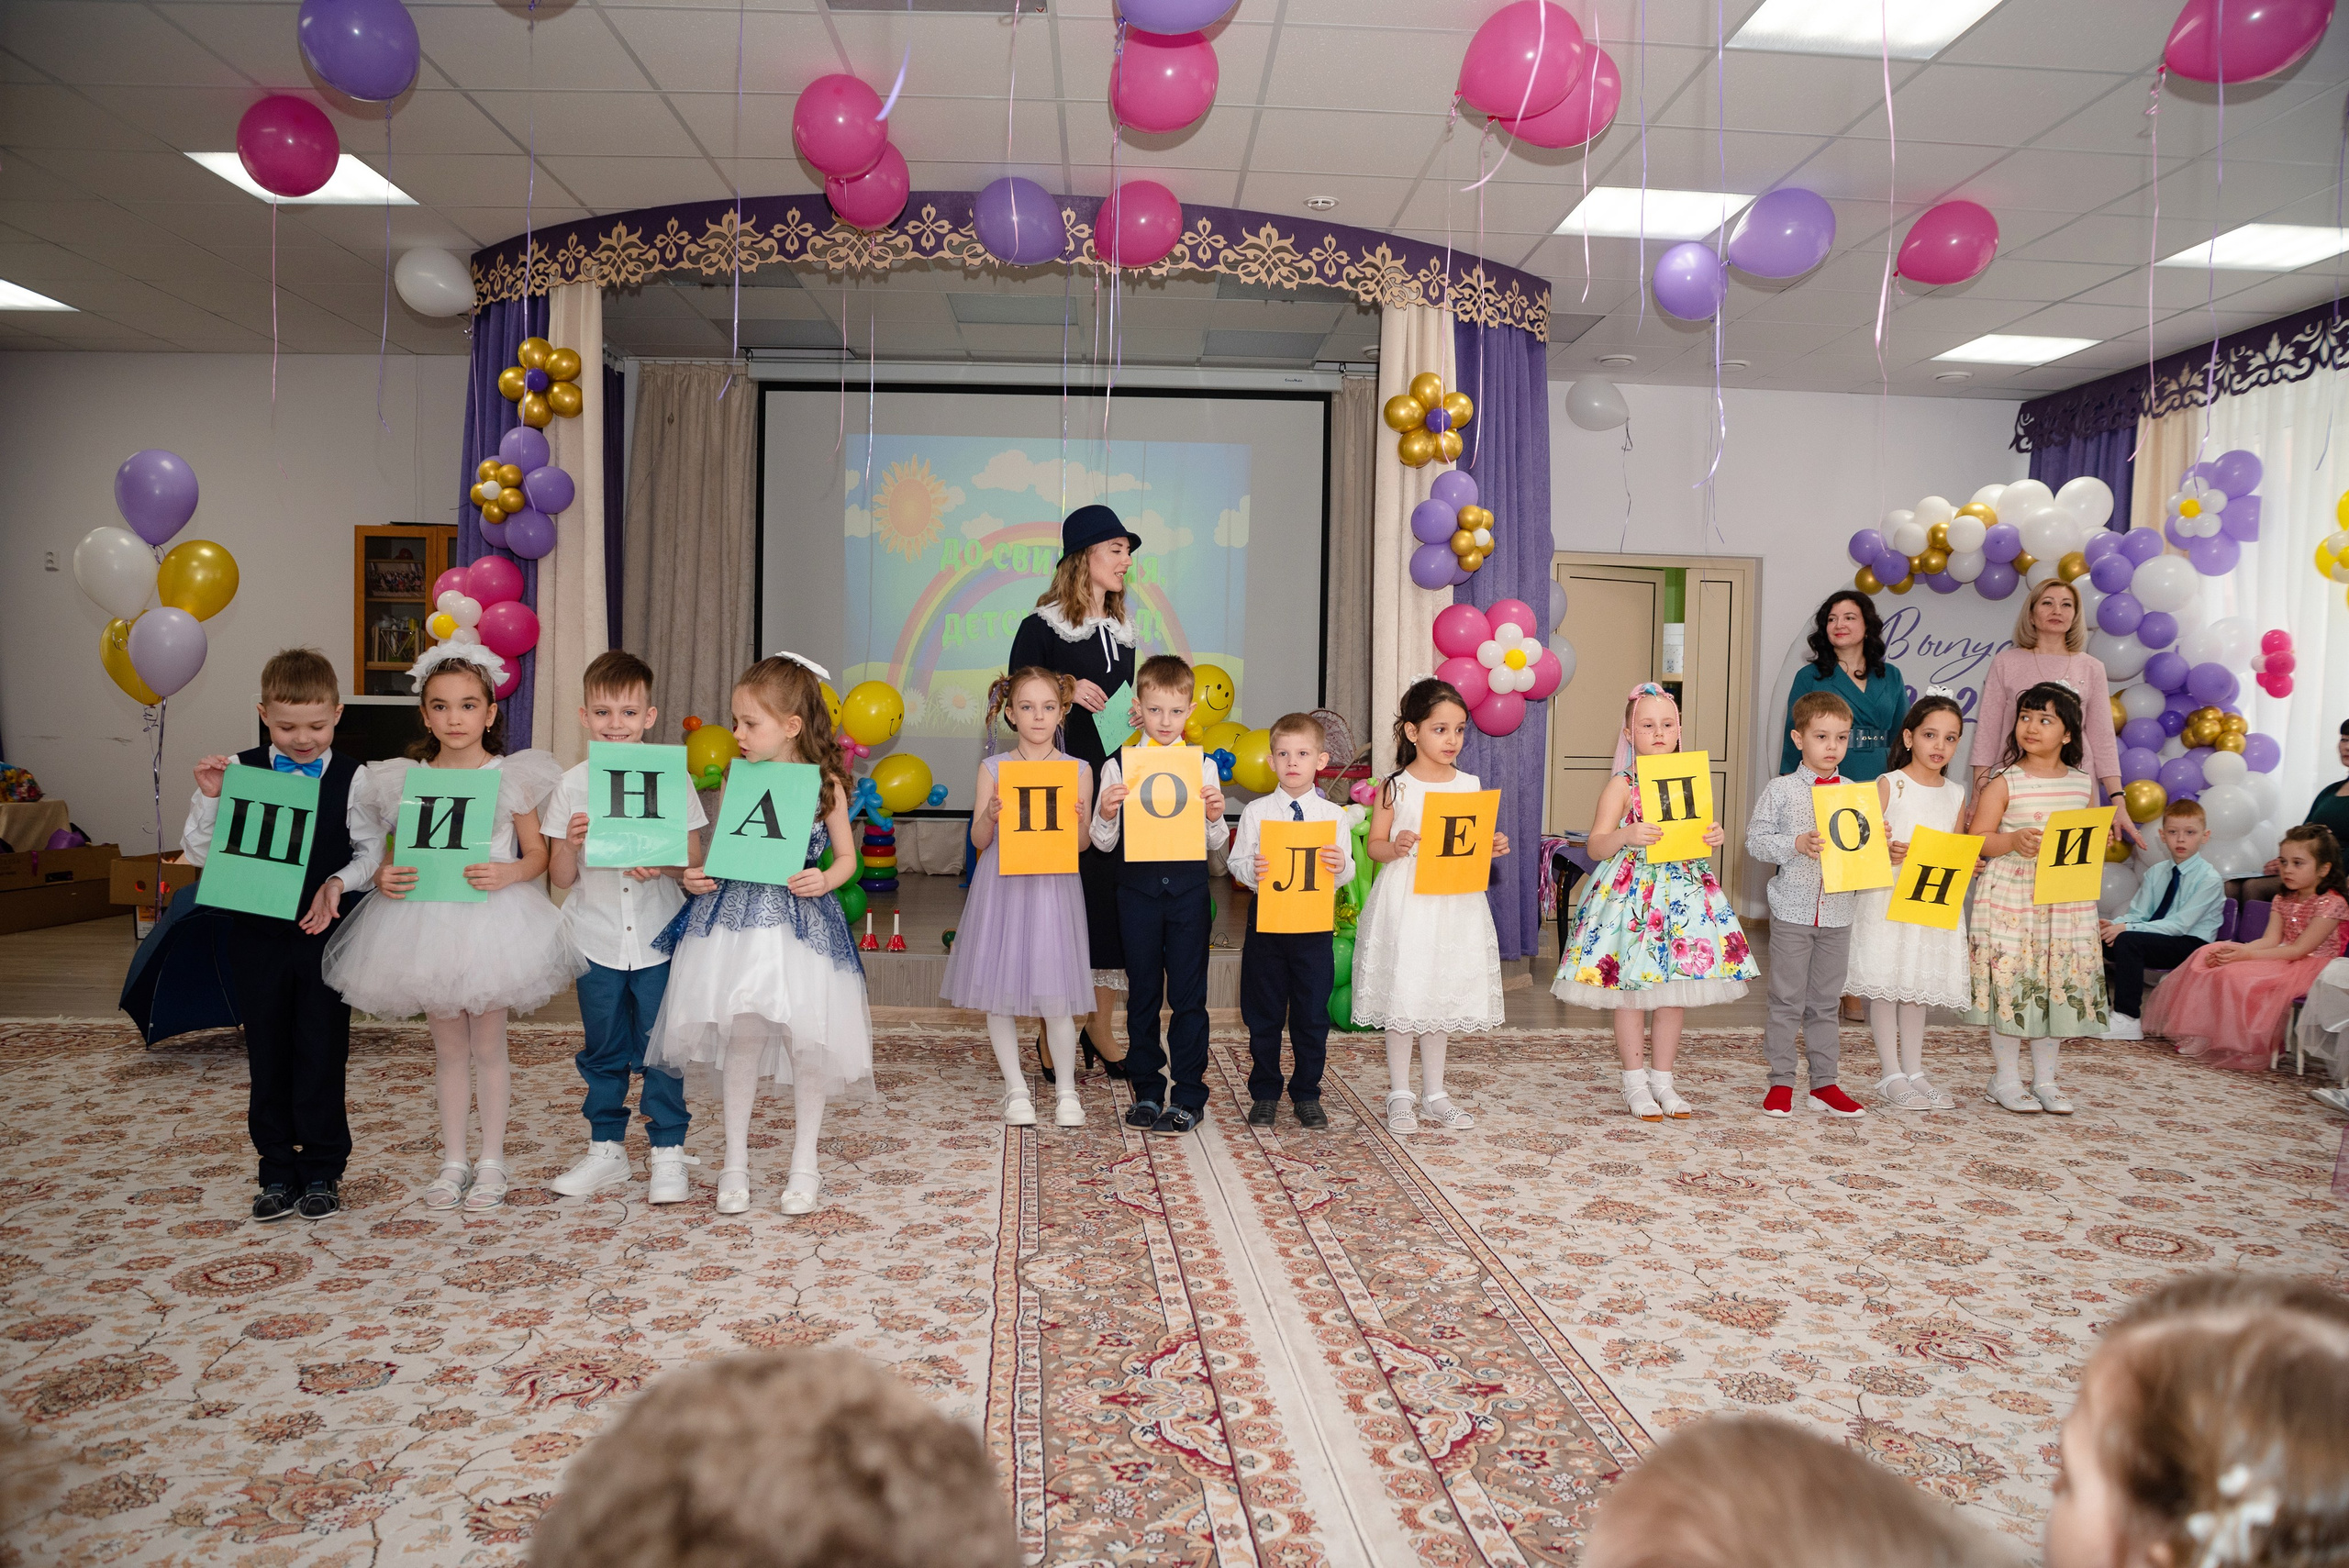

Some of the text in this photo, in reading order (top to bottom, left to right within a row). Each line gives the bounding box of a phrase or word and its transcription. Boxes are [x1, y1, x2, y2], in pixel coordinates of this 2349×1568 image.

[940, 538, 983, 571] ДО
[602, 769, 667, 819] Н
[729, 787, 787, 840] А
[1012, 784, 1064, 832] П
[1140, 772, 1187, 818] О
[1651, 774, 1702, 823] П
[218, 795, 314, 867] Ш
[406, 795, 477, 850] И
[1435, 814, 1478, 858] Е
[1828, 807, 1871, 852] О
[1272, 846, 1322, 893] Л
[2049, 825, 2099, 868] И
[1905, 862, 1961, 906] Н
